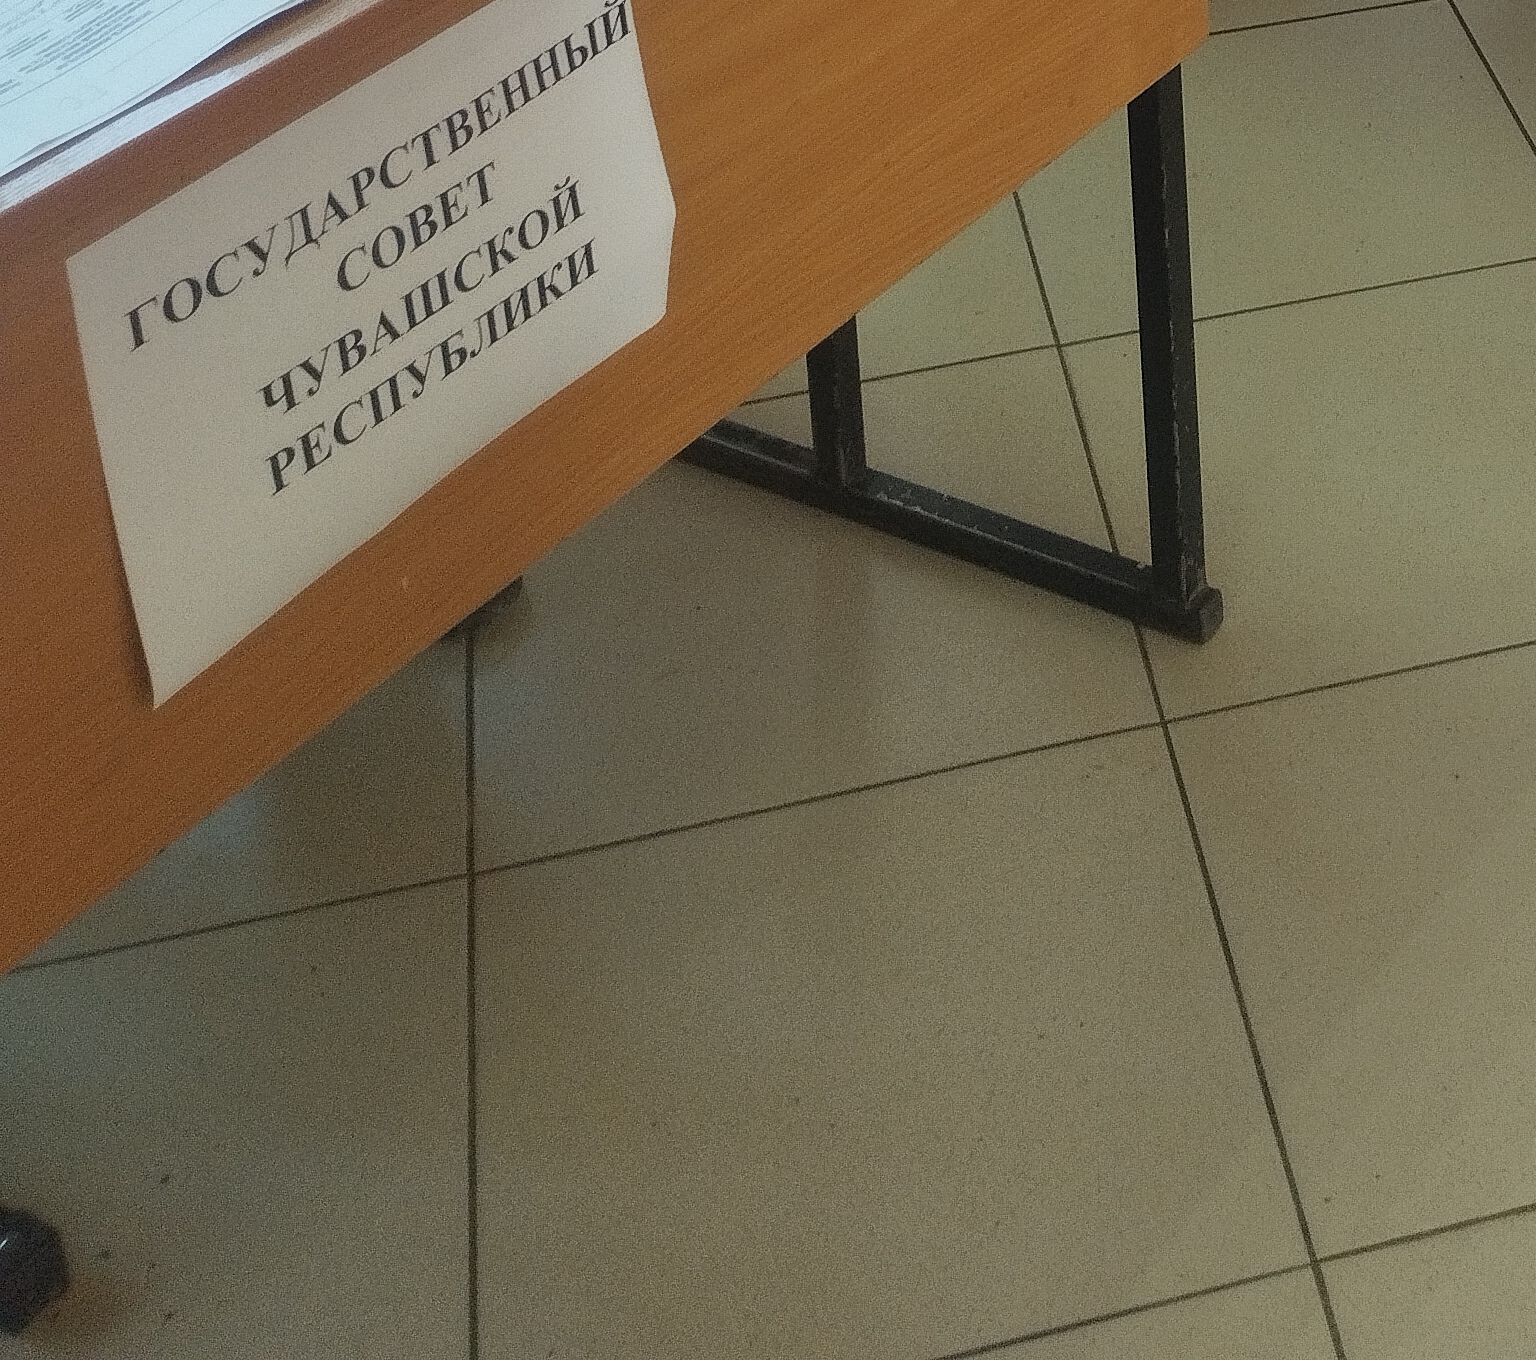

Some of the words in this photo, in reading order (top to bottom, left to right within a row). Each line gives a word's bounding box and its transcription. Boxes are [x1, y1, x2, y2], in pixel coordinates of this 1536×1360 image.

[256, 175, 586, 415] ЧУВАШСКОЙ
[335, 160, 499, 293] СОВЕТ
[263, 237, 600, 497] РЕСПУБЛИКИ
